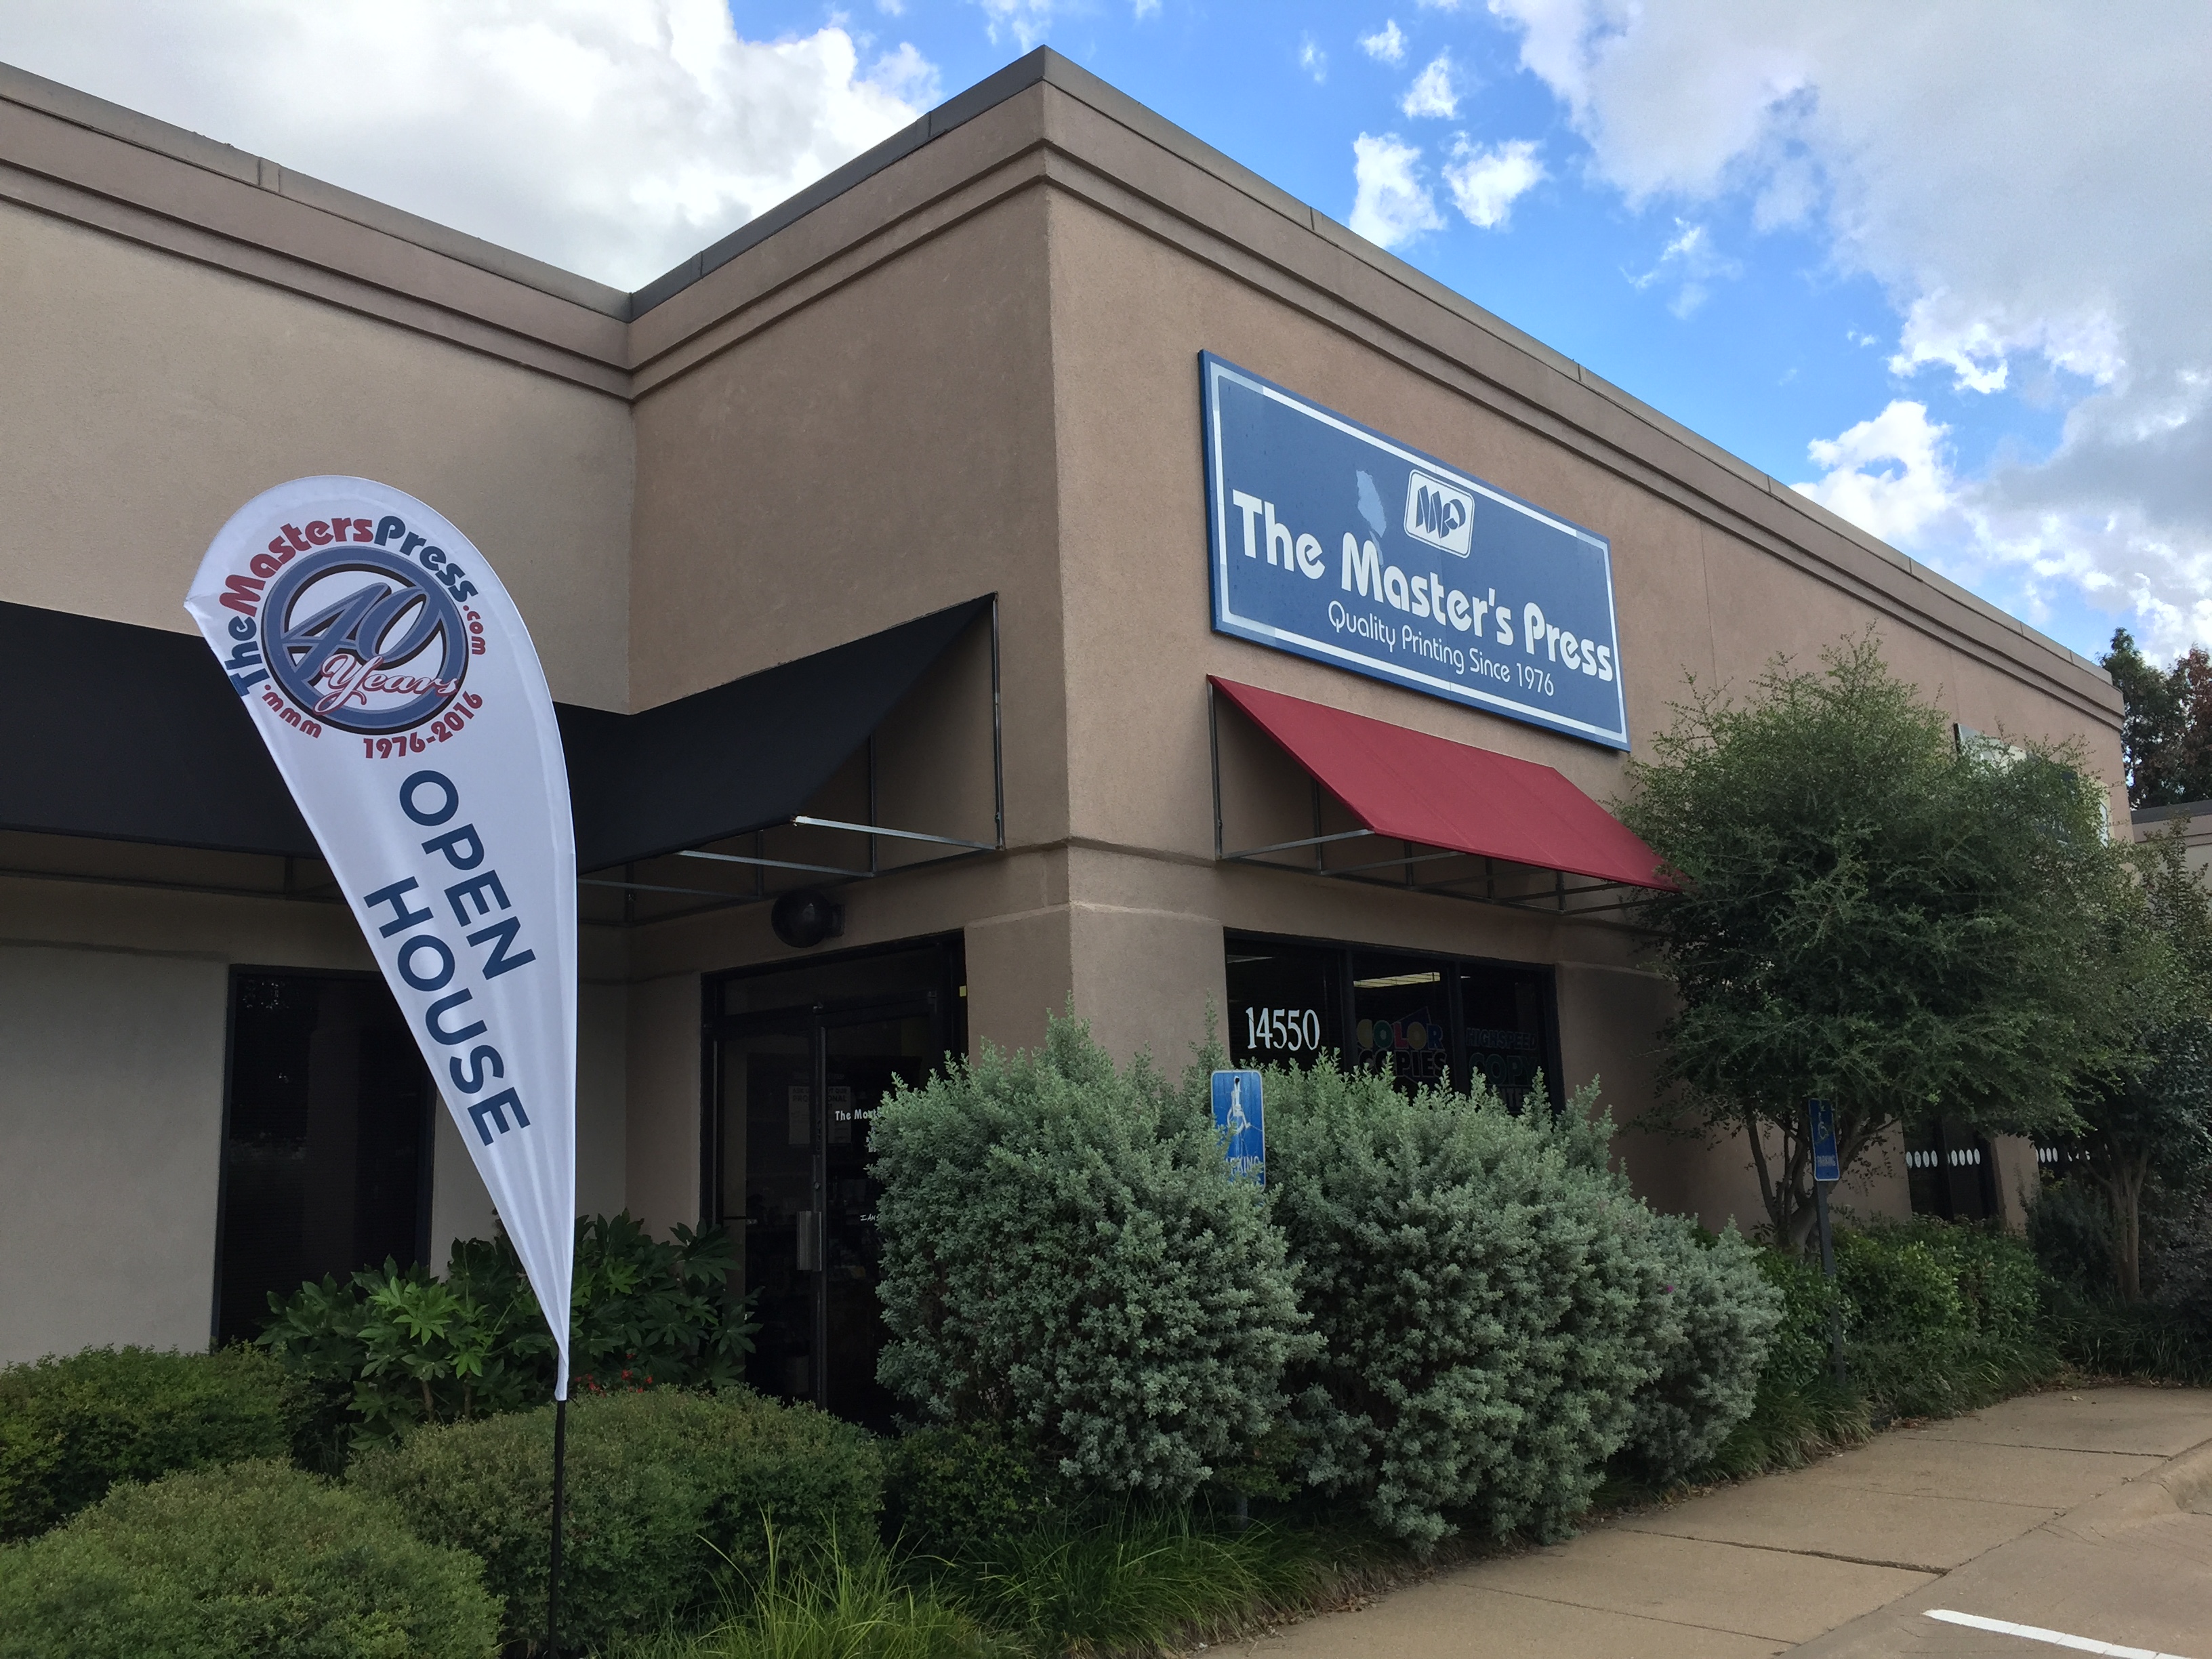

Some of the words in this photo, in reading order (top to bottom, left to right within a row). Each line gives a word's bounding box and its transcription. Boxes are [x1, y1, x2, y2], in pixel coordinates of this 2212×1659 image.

[1232, 489, 1326, 579] The
[1341, 532, 1514, 646] Master's
[1523, 602, 1614, 682] Press
[281, 582, 431, 683] 40
[1328, 600, 1396, 653] Quality
[1401, 625, 1465, 676] Printing
[1469, 648, 1511, 682] Since
[1515, 661, 1555, 697] 1976
[312, 654, 459, 716] Years
[363, 693, 483, 760] 1976-2016
[399, 770, 537, 981] OPEN
[363, 876, 531, 1147] HOUSE
[1246, 1006, 1320, 1052] 14550
[1356, 1018, 1445, 1050] COLOR
[1358, 1048, 1448, 1078] COPIES
[1468, 1051, 1540, 1086] COPY
[835, 1110, 852, 1122] The
